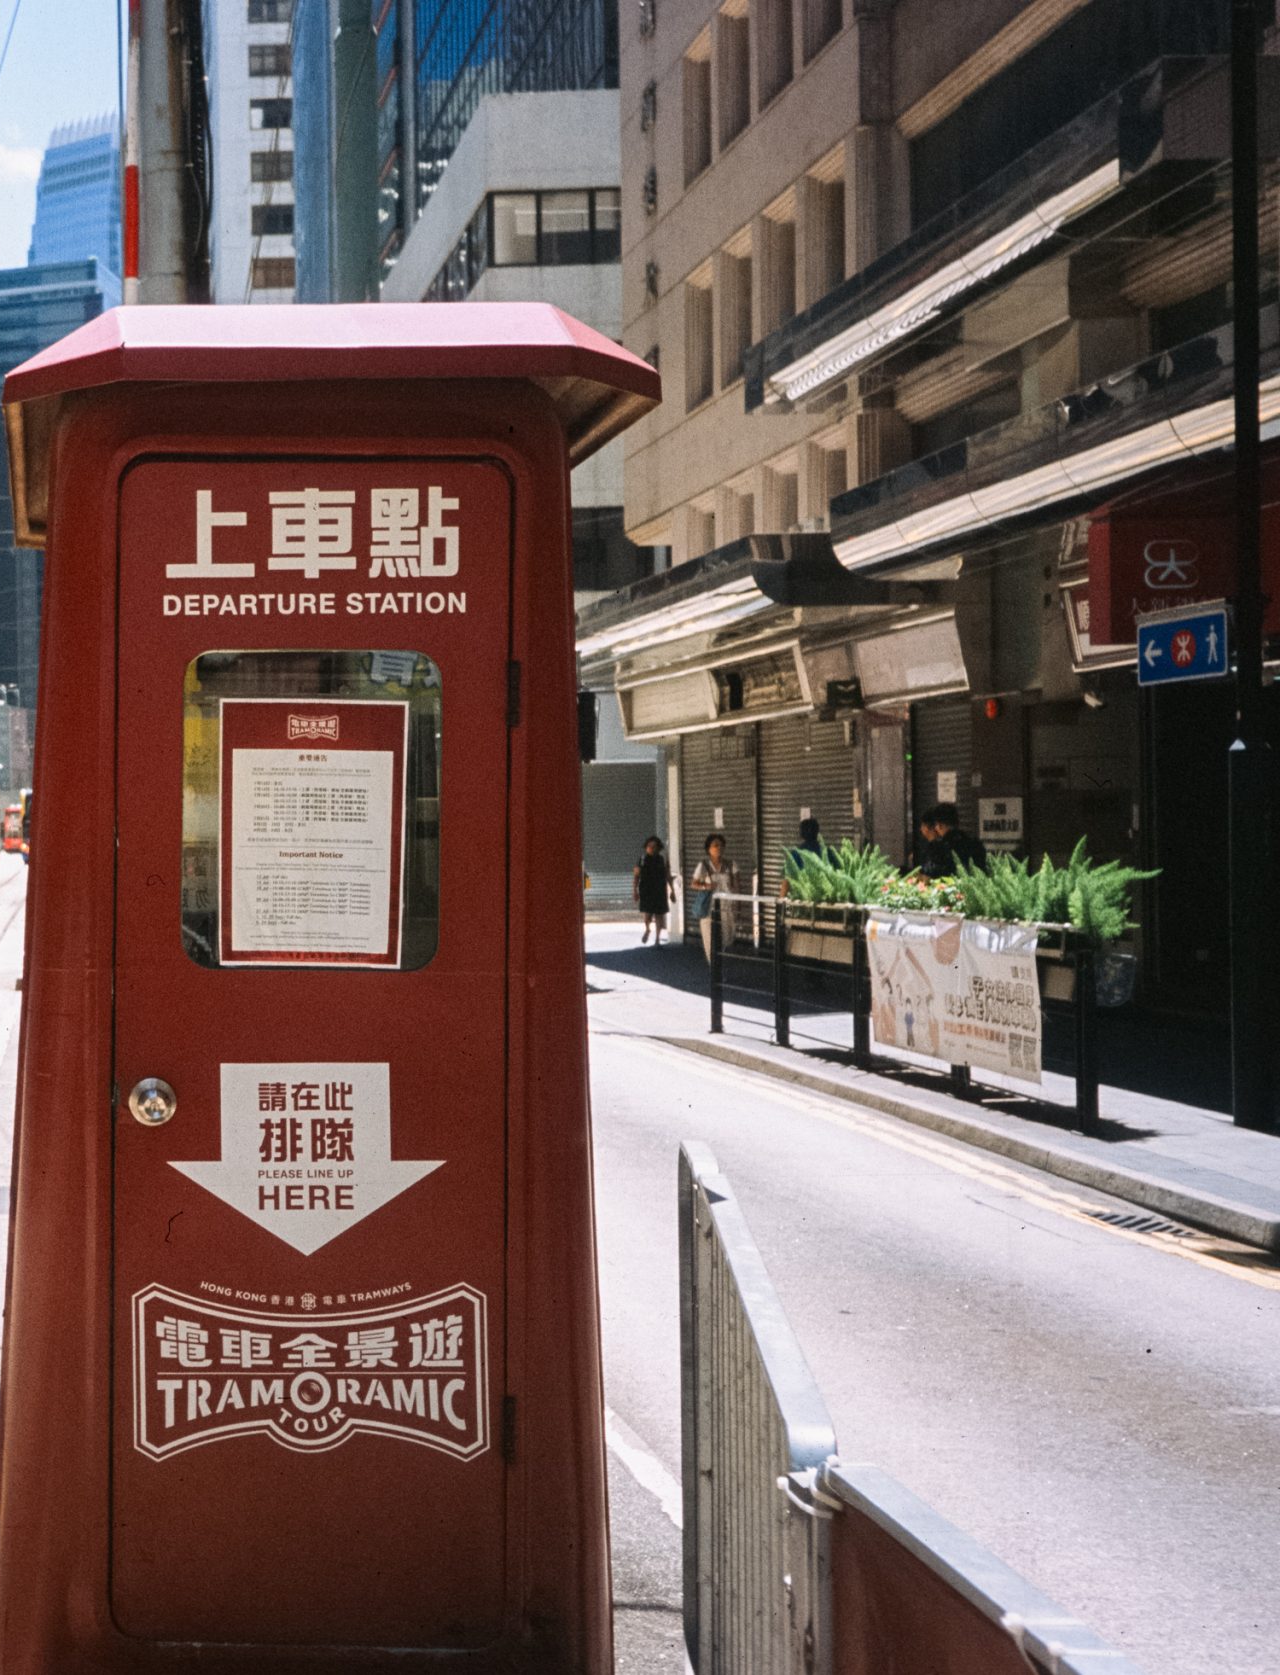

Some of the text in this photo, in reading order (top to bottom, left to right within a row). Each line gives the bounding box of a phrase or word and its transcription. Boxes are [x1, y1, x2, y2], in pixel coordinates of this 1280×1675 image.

[165, 486, 460, 579] 上車點
[162, 591, 468, 616] DEPARTURE STATION
[279, 850, 344, 861] Important Notice
[257, 1081, 355, 1112] 請在此
[258, 1117, 356, 1164] 排隊
[257, 1168, 355, 1180] PLEASE LINE UP
[258, 1184, 356, 1211] HERE
[199, 1281, 412, 1306] HONG KONG 香港 電車 TRAMWAYS
[155, 1314, 464, 1369] 電車全景遊
[156, 1371, 467, 1431] TRAMORAMIC
[278, 1406, 347, 1433] TOUR
